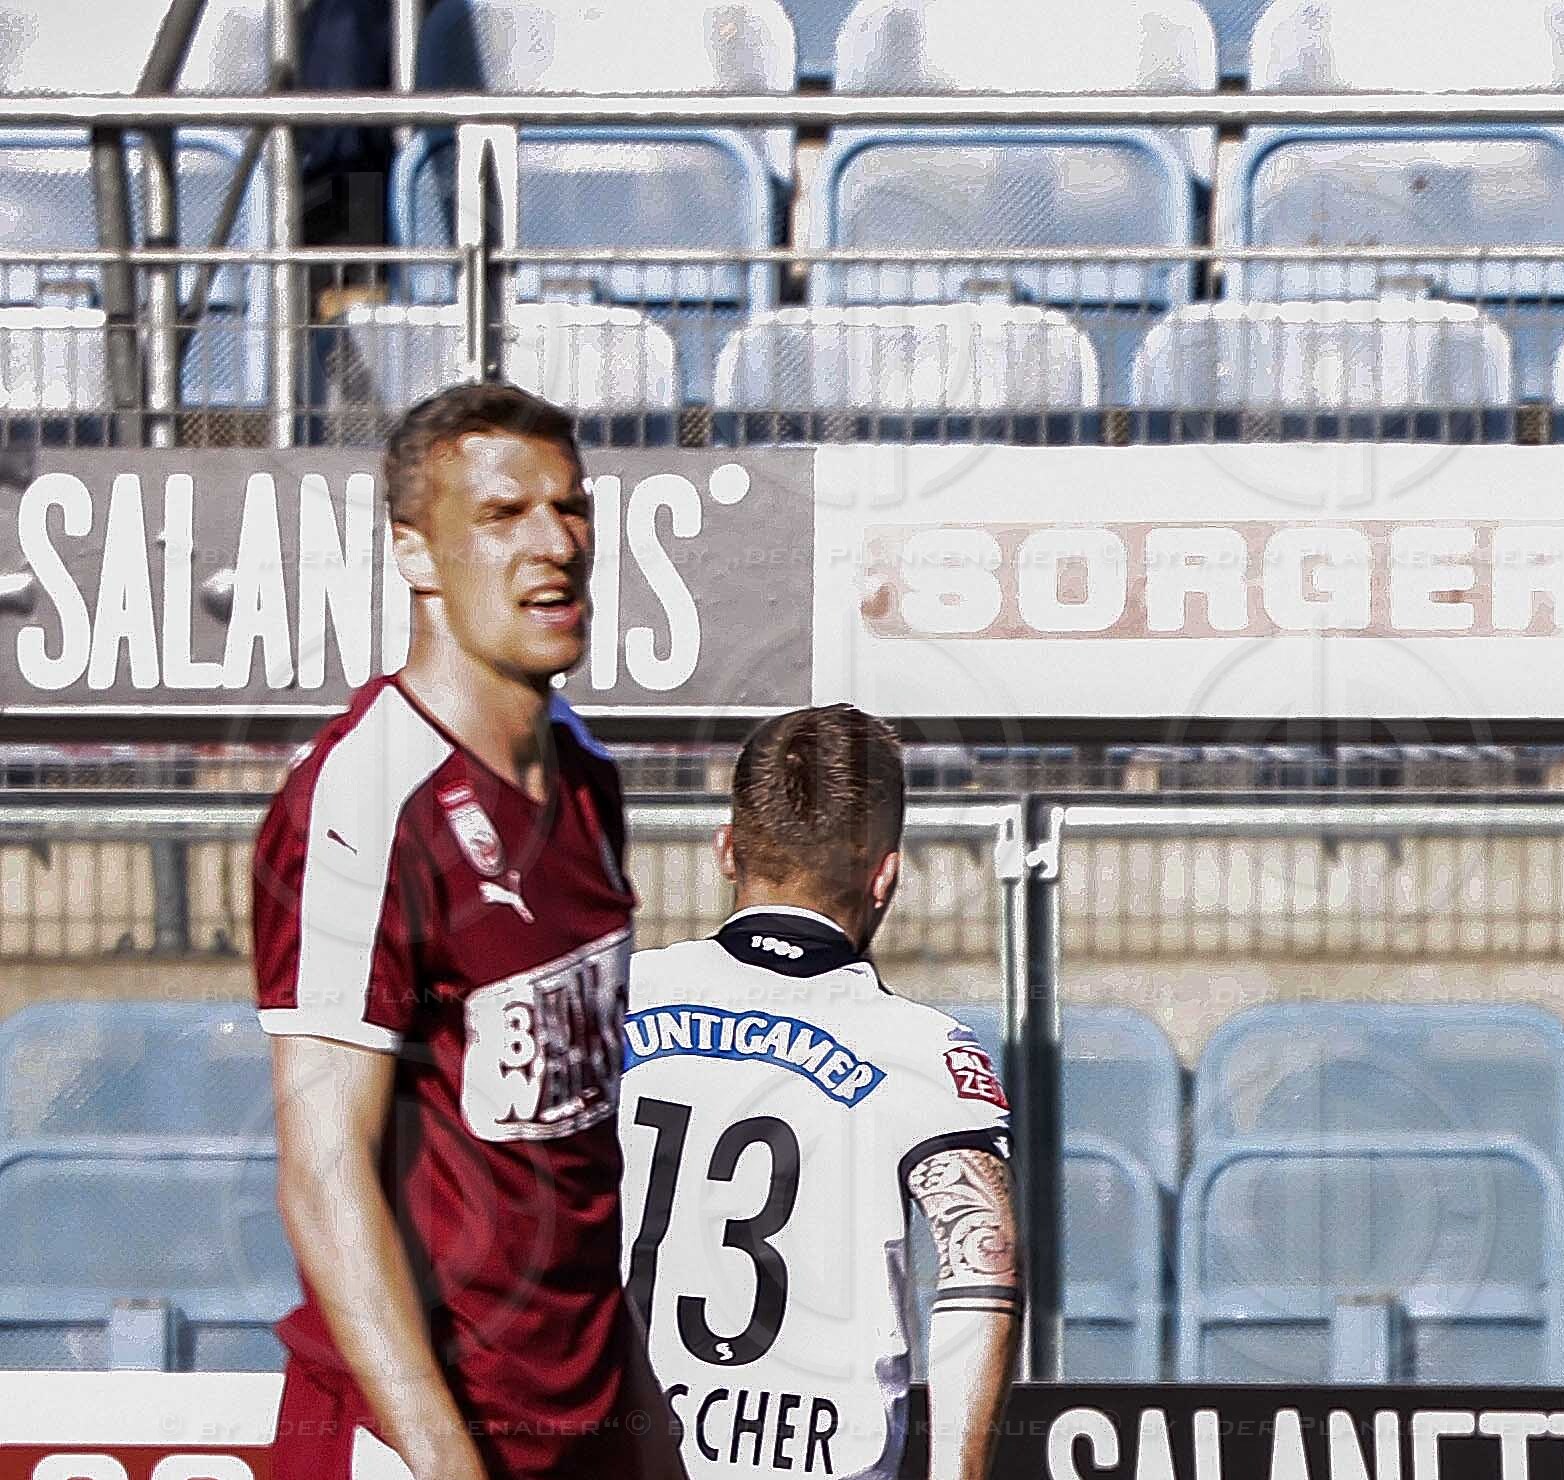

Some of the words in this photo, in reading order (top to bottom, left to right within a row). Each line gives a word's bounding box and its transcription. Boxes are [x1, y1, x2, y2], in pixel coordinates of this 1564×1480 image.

[17, 471, 702, 690] SALANIS
[624, 1011, 873, 1099] UNTIGAMER
[623, 1097, 801, 1366] 13
[664, 1384, 834, 1475] SCHER
